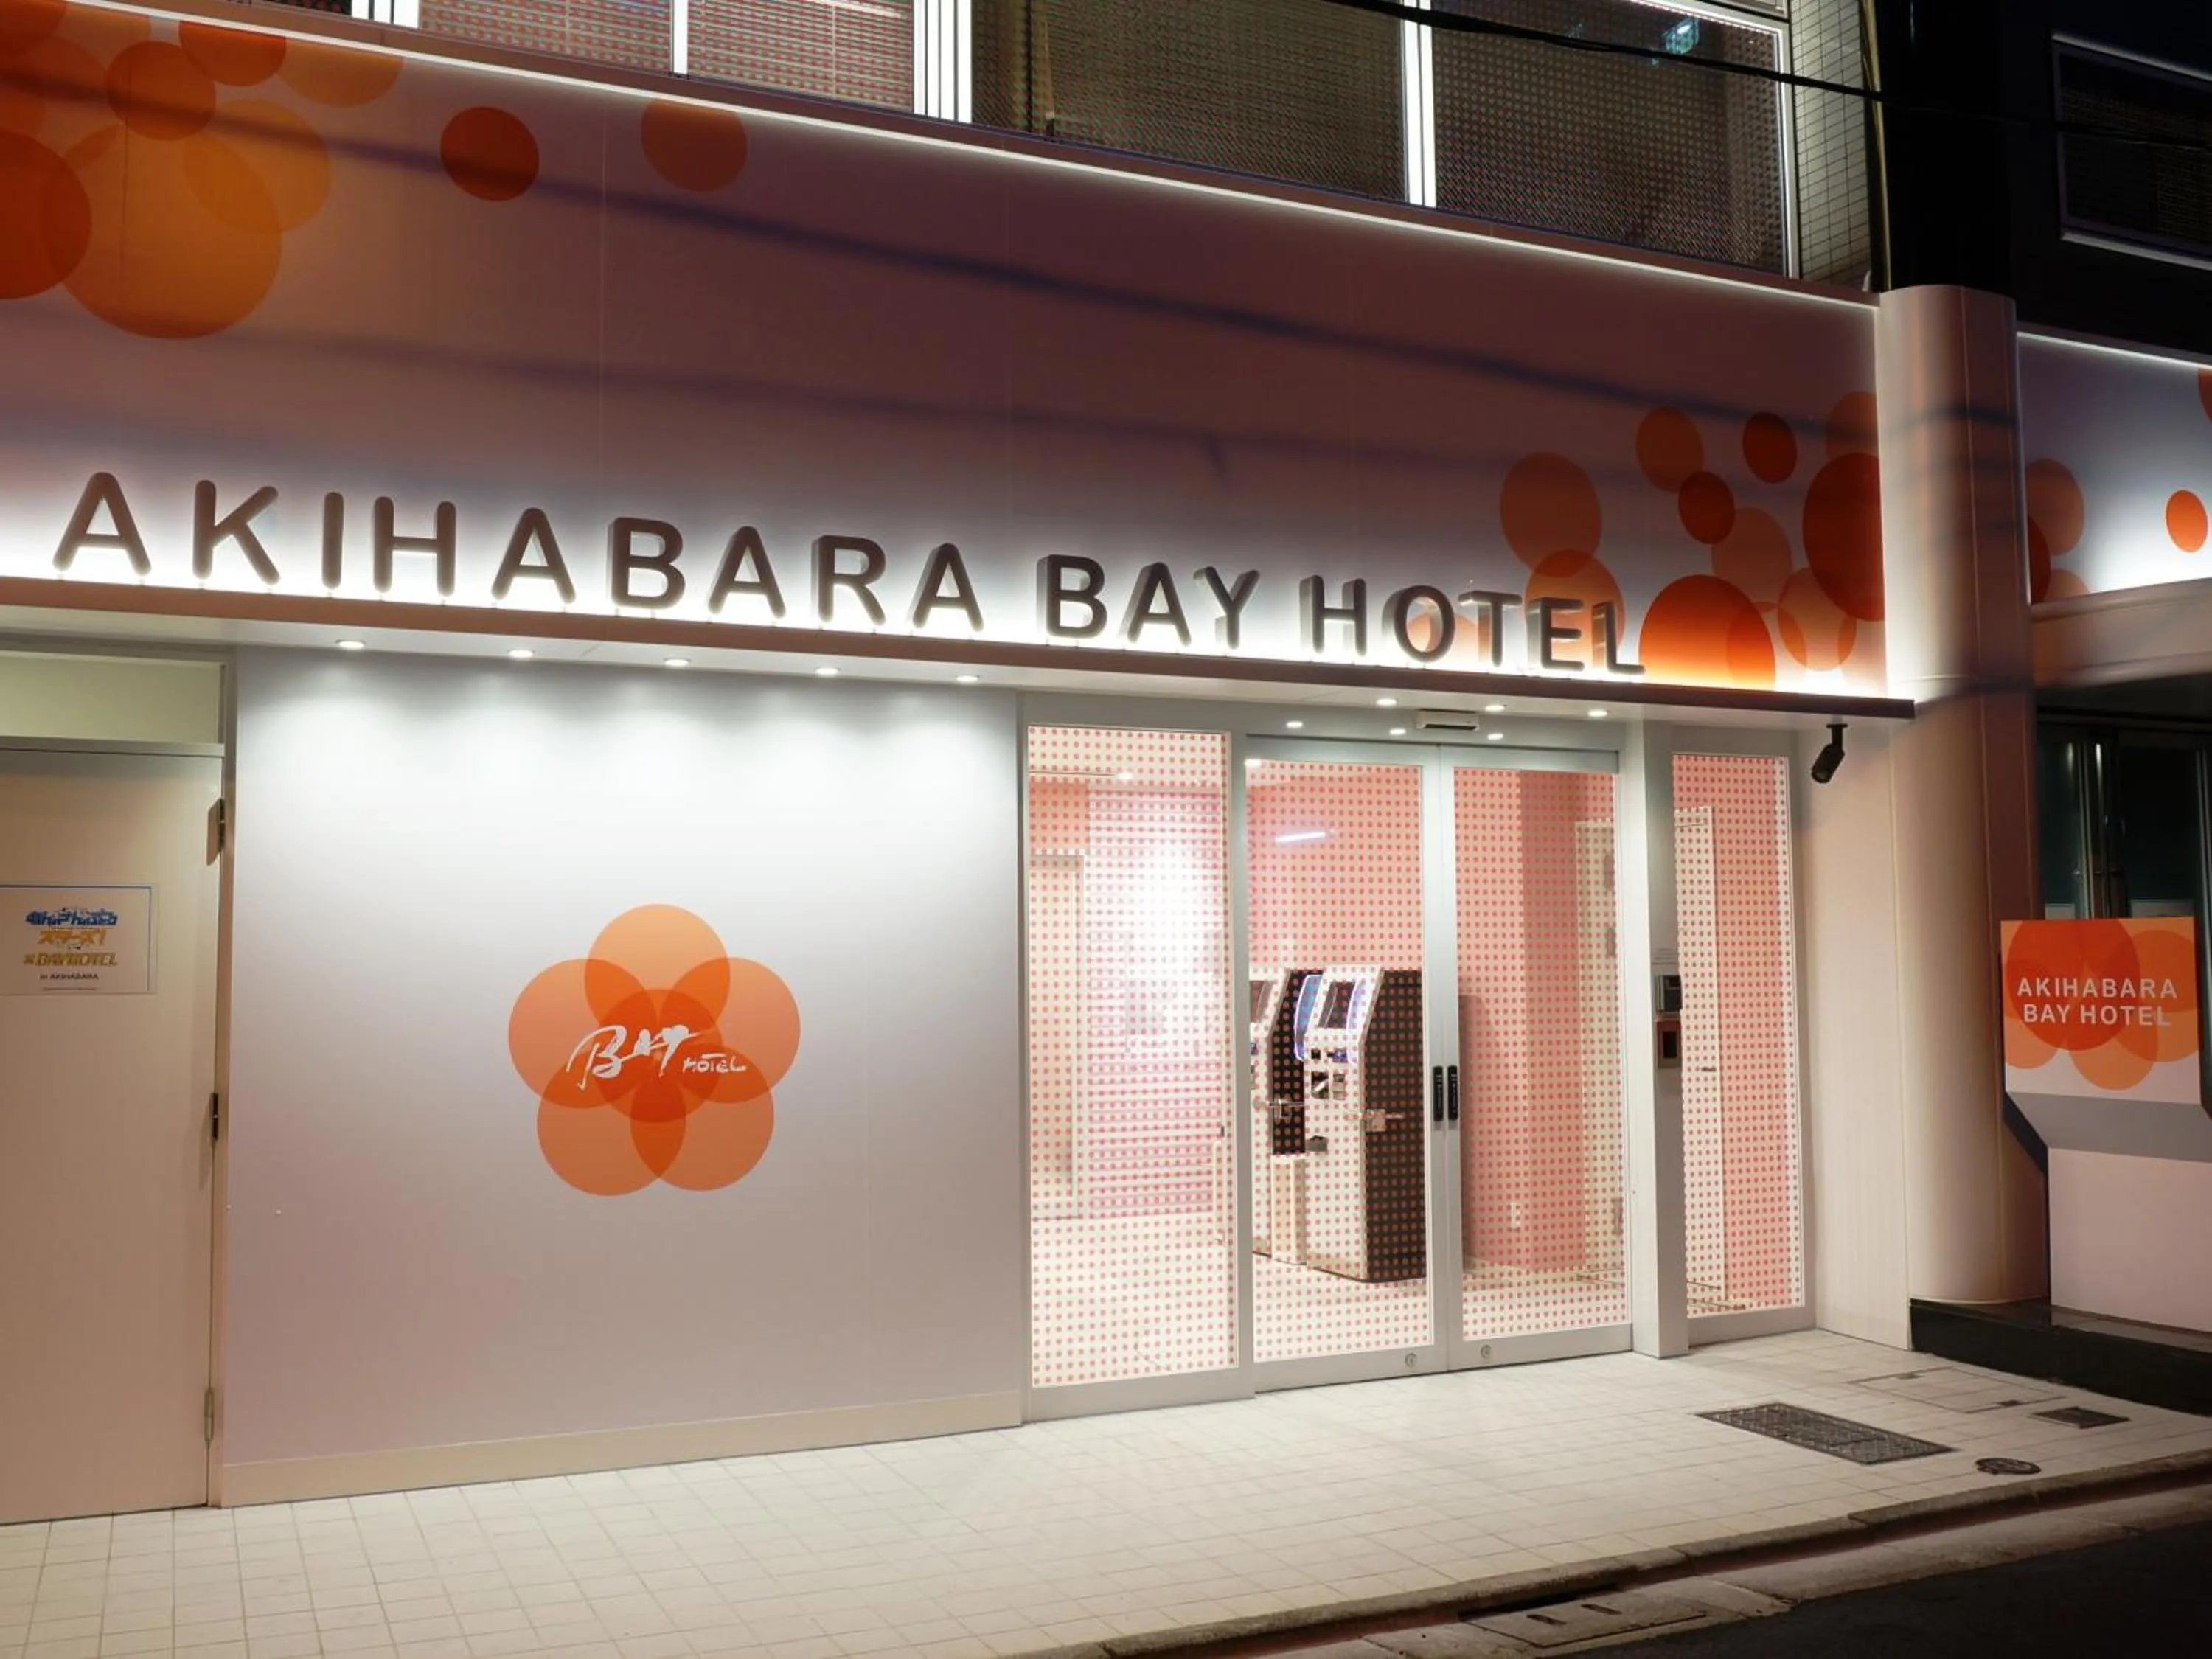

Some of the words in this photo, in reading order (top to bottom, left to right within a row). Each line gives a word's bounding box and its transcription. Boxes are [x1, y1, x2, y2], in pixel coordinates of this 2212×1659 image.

[52, 471, 985, 632] AKIHABARA
[1036, 553, 1261, 650] BAY
[1298, 574, 1646, 676] HOTEL
[2017, 977, 2177, 999] AKIHABARA
[2023, 1004, 2071, 1024] BAY
[2080, 1004, 2171, 1027] HOTEL
[682, 1052, 747, 1074] HOTEL
